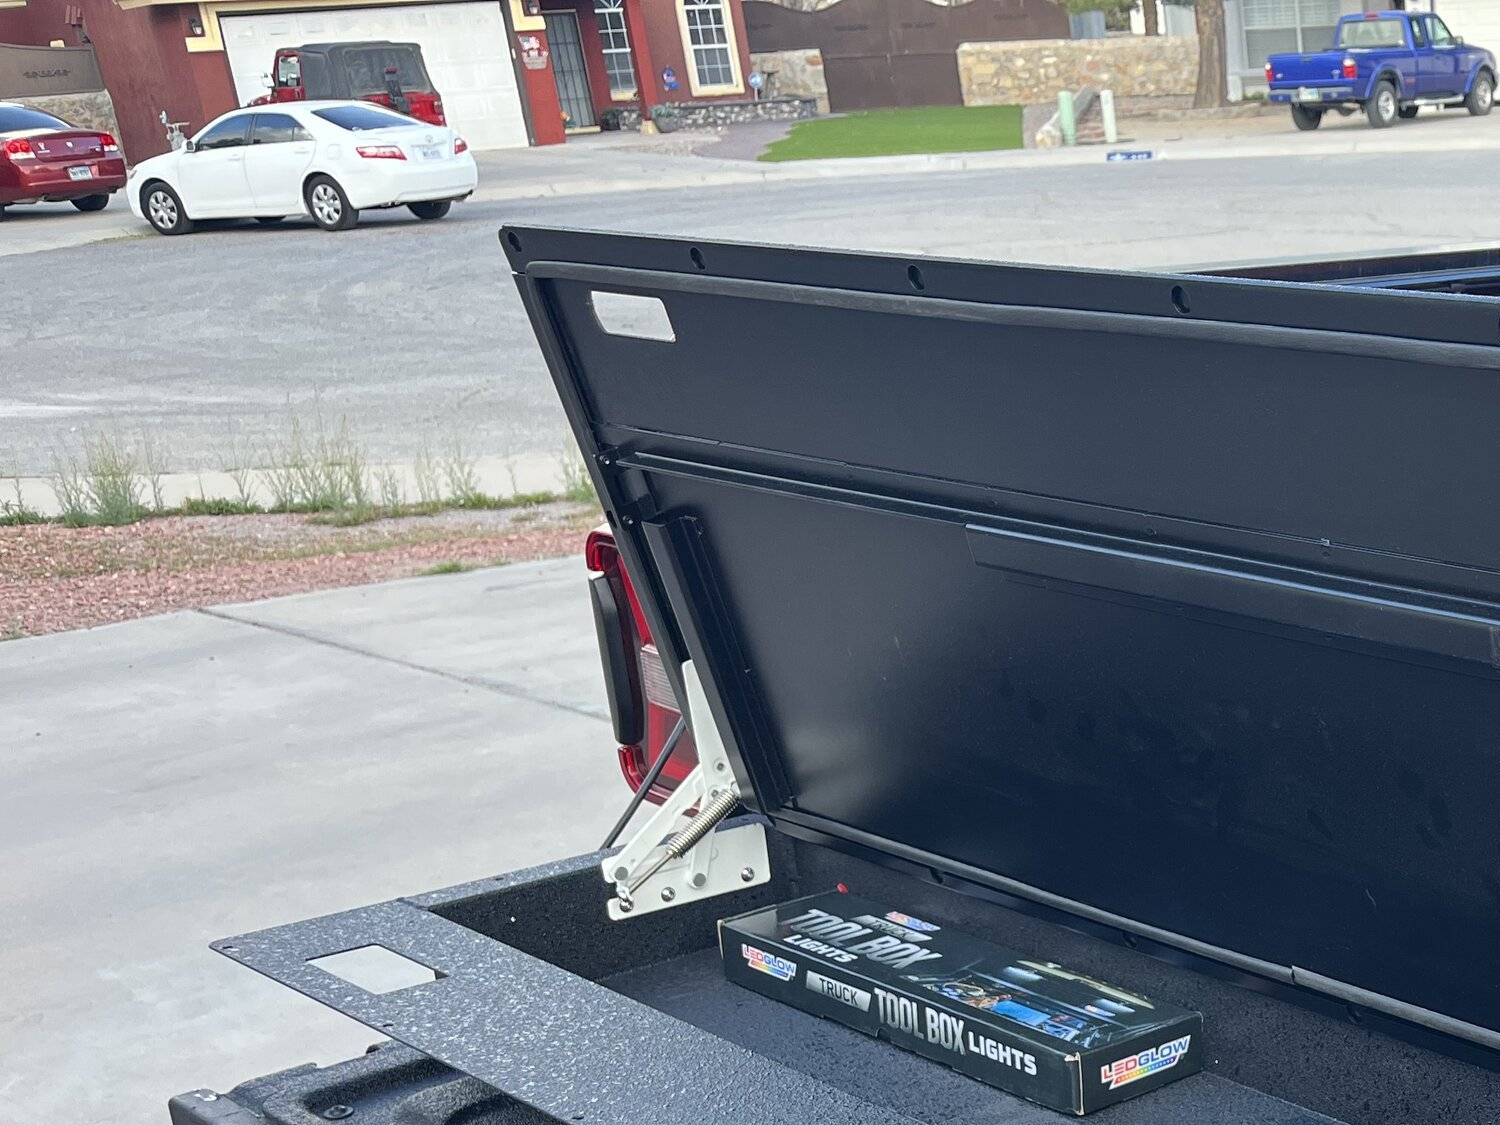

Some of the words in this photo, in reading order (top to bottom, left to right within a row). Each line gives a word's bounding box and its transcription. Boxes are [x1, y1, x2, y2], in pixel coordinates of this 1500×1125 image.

[781, 908, 873, 947] TOOL
[845, 935, 943, 970] BOX
[784, 934, 859, 963] LIGHTS
[742, 945, 796, 975] LEDGLOW
[818, 977, 860, 1007] TRUCK
[873, 987, 925, 1040] TOOL
[926, 1013, 967, 1056] BOX
[968, 1031, 1038, 1076] LIGHTS
[1103, 1039, 1188, 1079] LEDGLOW
